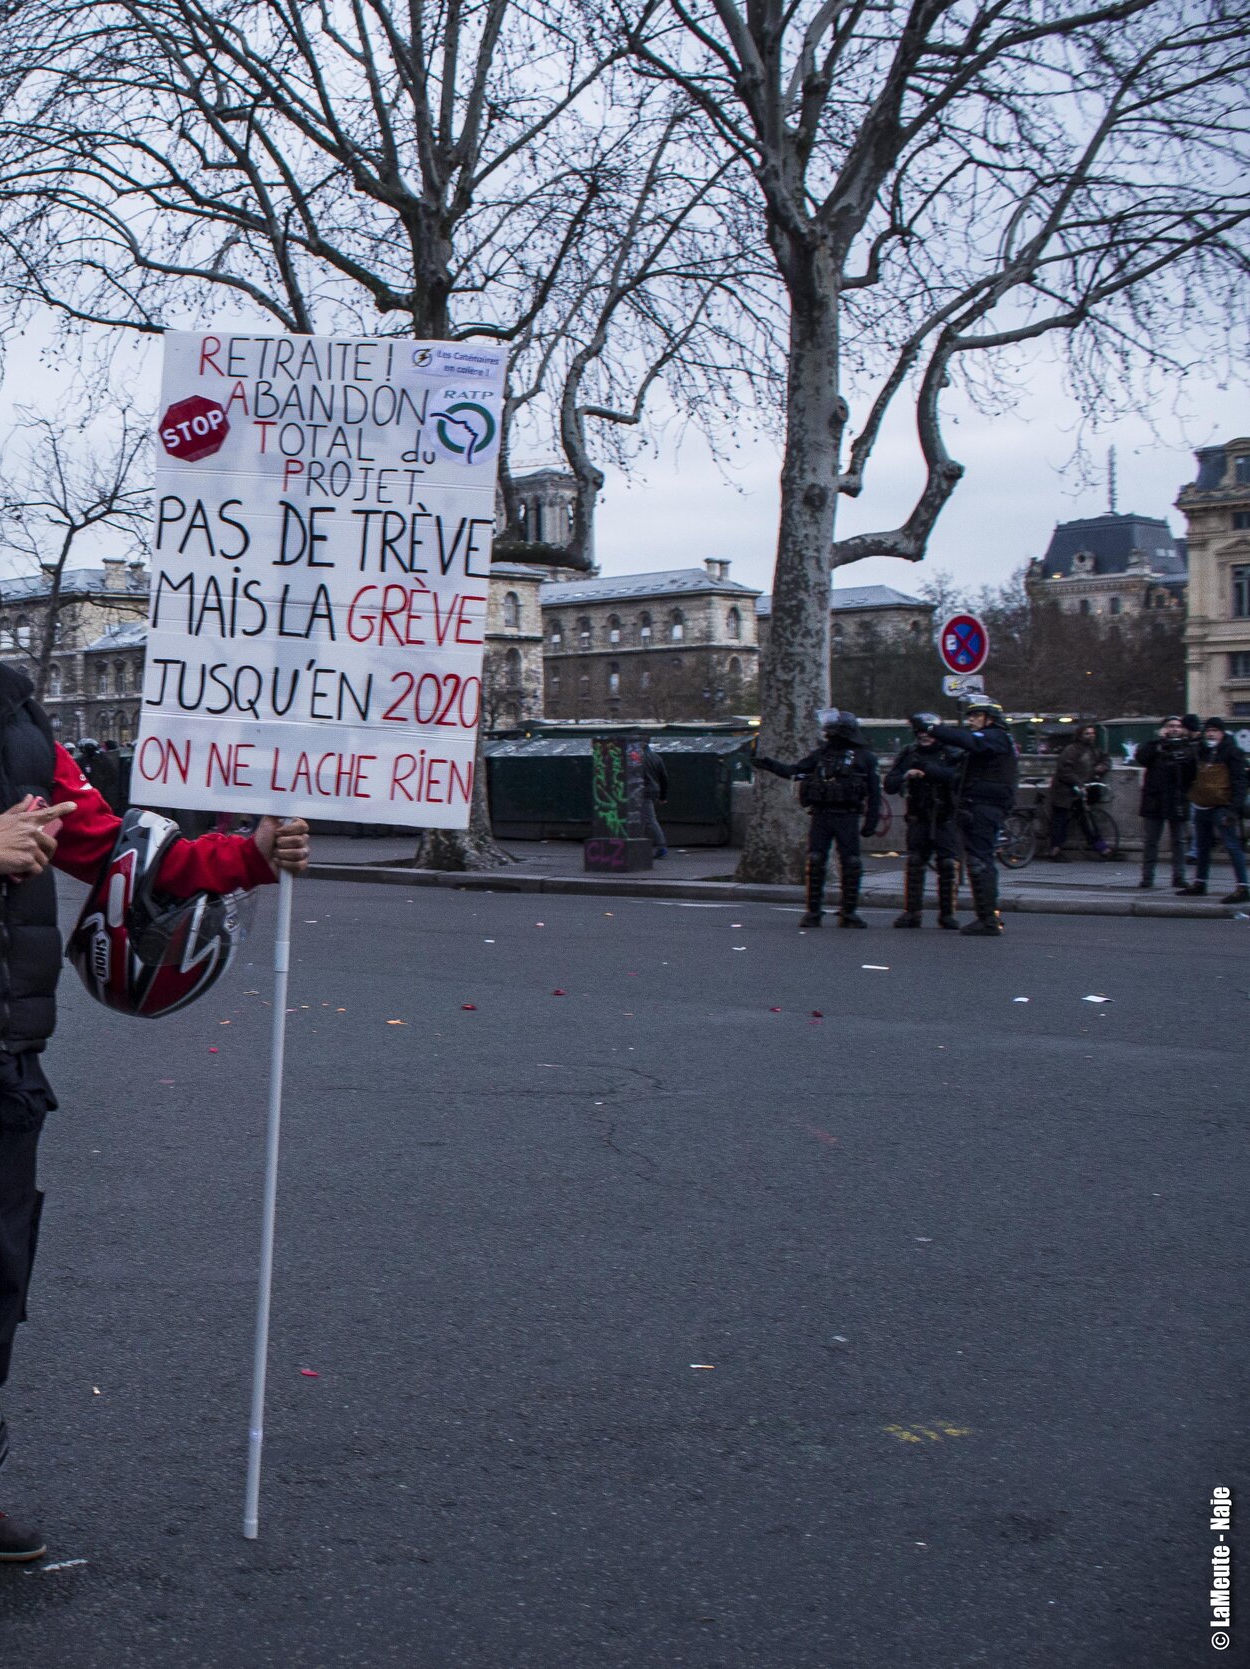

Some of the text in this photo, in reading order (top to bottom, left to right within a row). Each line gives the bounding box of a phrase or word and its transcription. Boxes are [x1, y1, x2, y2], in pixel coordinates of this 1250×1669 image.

[224, 380, 430, 427] ABANDON
[443, 390, 495, 400] RATP
[162, 409, 225, 449] STOP
[254, 421, 436, 465] TOTAL du
[283, 459, 425, 505] PROJET
[156, 496, 494, 578] PAS DE TRÈVE
[278, 583, 336, 642] LA
[347, 577, 487, 647] GRÈVE
[145, 658, 482, 729] JUSQU'EN 2020
[139, 736, 191, 784] ON
[206, 742, 255, 788] NE
[270, 747, 377, 799] LACHE
